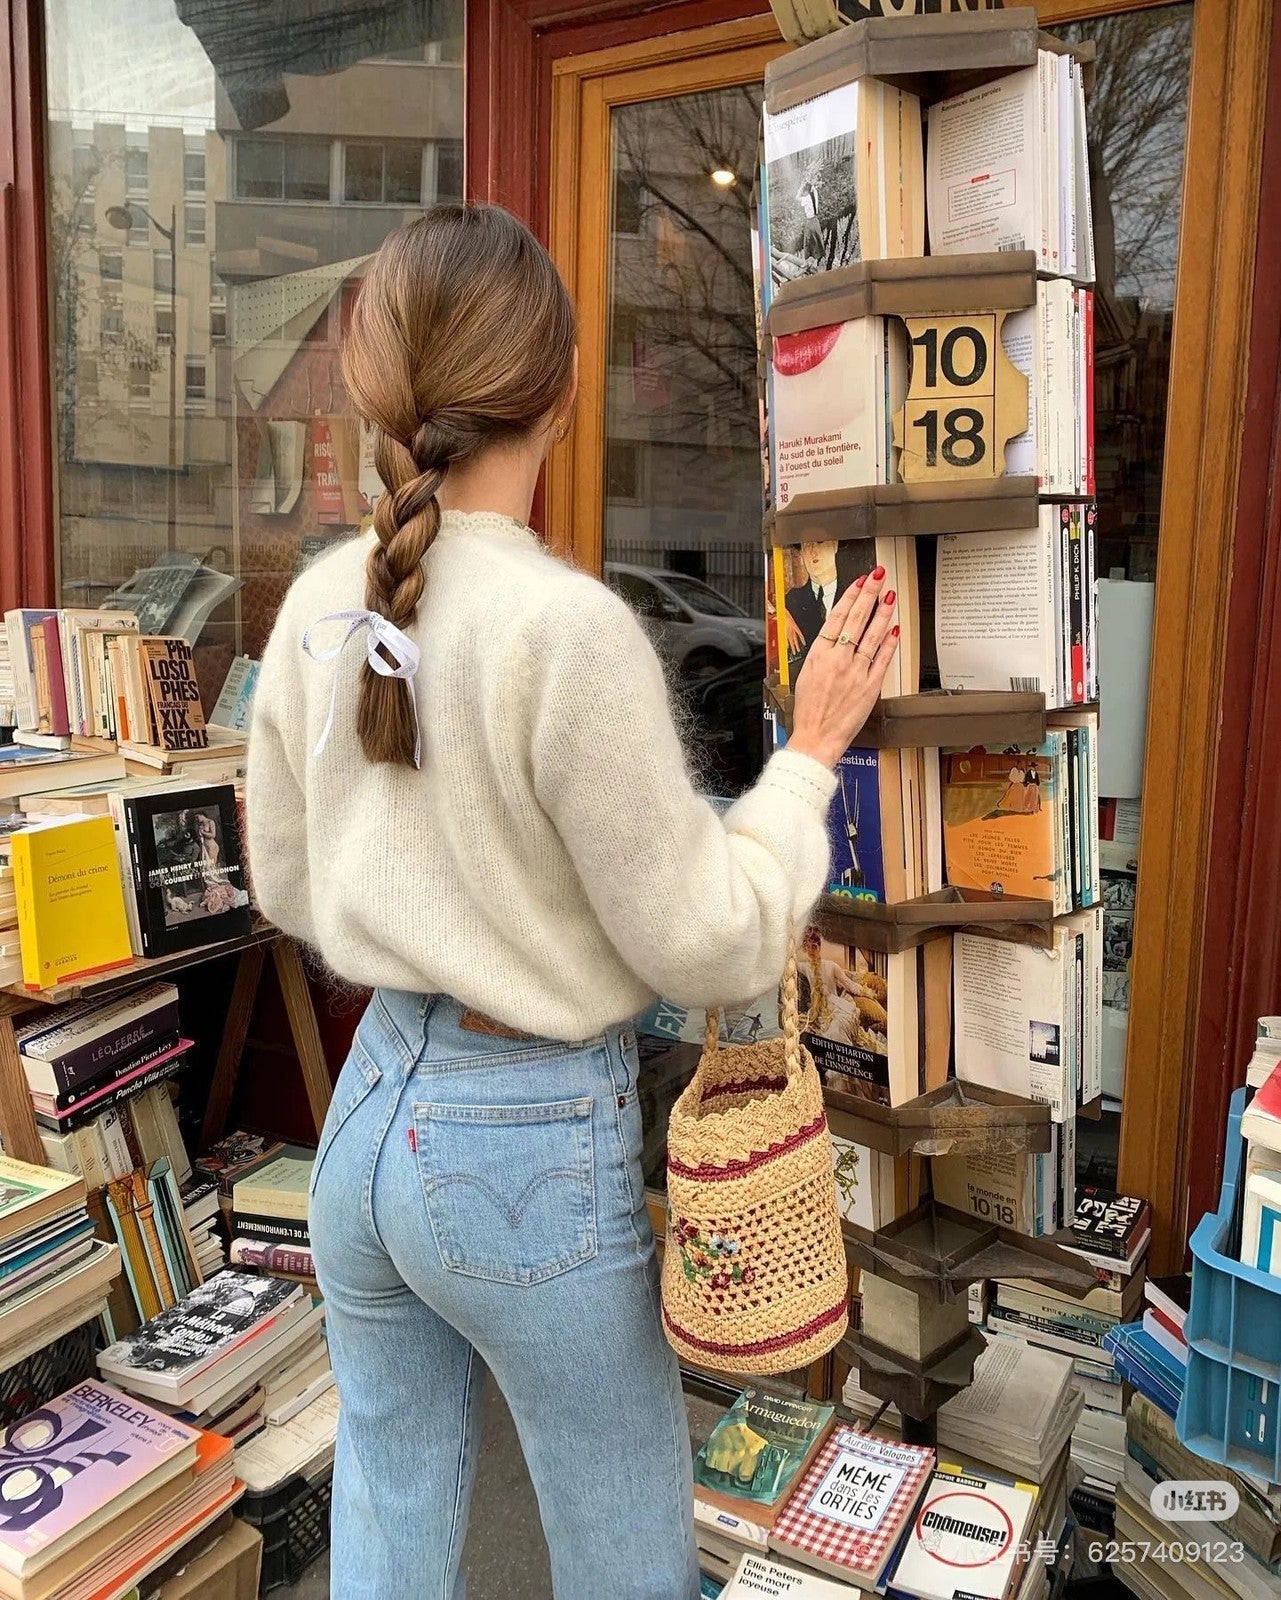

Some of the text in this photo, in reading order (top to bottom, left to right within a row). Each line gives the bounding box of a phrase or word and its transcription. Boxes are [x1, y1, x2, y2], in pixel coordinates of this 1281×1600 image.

[912, 326, 988, 388] 10
[779, 430, 842, 450] Haruki Murakami
[912, 407, 986, 467] 18
[780, 441, 861, 461] Au sud de la frontière,
[780, 455, 844, 473] à l'ouest du soleil
[780, 482, 788, 492] 10
[780, 493, 789, 503] 18
[150, 659, 190, 681] LOSO
[159, 680, 200, 702] PHES
[865, 756, 877, 767] de
[48, 865, 109, 884] Démons du crime
[147, 866, 168, 877] JAMES
[169, 861, 192, 873] HENRY
[163, 872, 194, 886] COURBET
[200, 863, 240, 879] PROUDHON
[91, 1024, 145, 1062] LÉO FERRÉ
[811, 1036, 874, 1062] EDITH WHARTON
[115, 1043, 172, 1077] Donation Pierre Lévy
[814, 1055, 874, 1080] DE L'INNOCENCE
[825, 1051, 861, 1068] AU TEMPS
[116, 1080, 143, 1100] Pancho
[967, 1182, 1017, 1205] le monde en
[970, 1195, 1014, 1225] 10 18
[237, 1221, 293, 1237] L'ENVIRONNEMENT
[293, 1228, 302, 1238] DE
[210, 1310, 227, 1321] La
[72, 1384, 156, 1428] BERKELEY
[763, 1394, 813, 1412] DAVID LIPPINCOTT
[737, 1400, 821, 1430] Armaguedon
[845, 1437, 917, 1463] Aurélie Valognes
[837, 1463, 892, 1493] MÉMÉ
[830, 1480, 882, 1505] dans les
[820, 1490, 877, 1520] ORTIES
[921, 1511, 1007, 1547] Chômeuse!
[742, 1568, 791, 1591] Une mort
[746, 1559, 803, 1586] Ellis Peters
[738, 1578, 780, 1597] joyeuse
